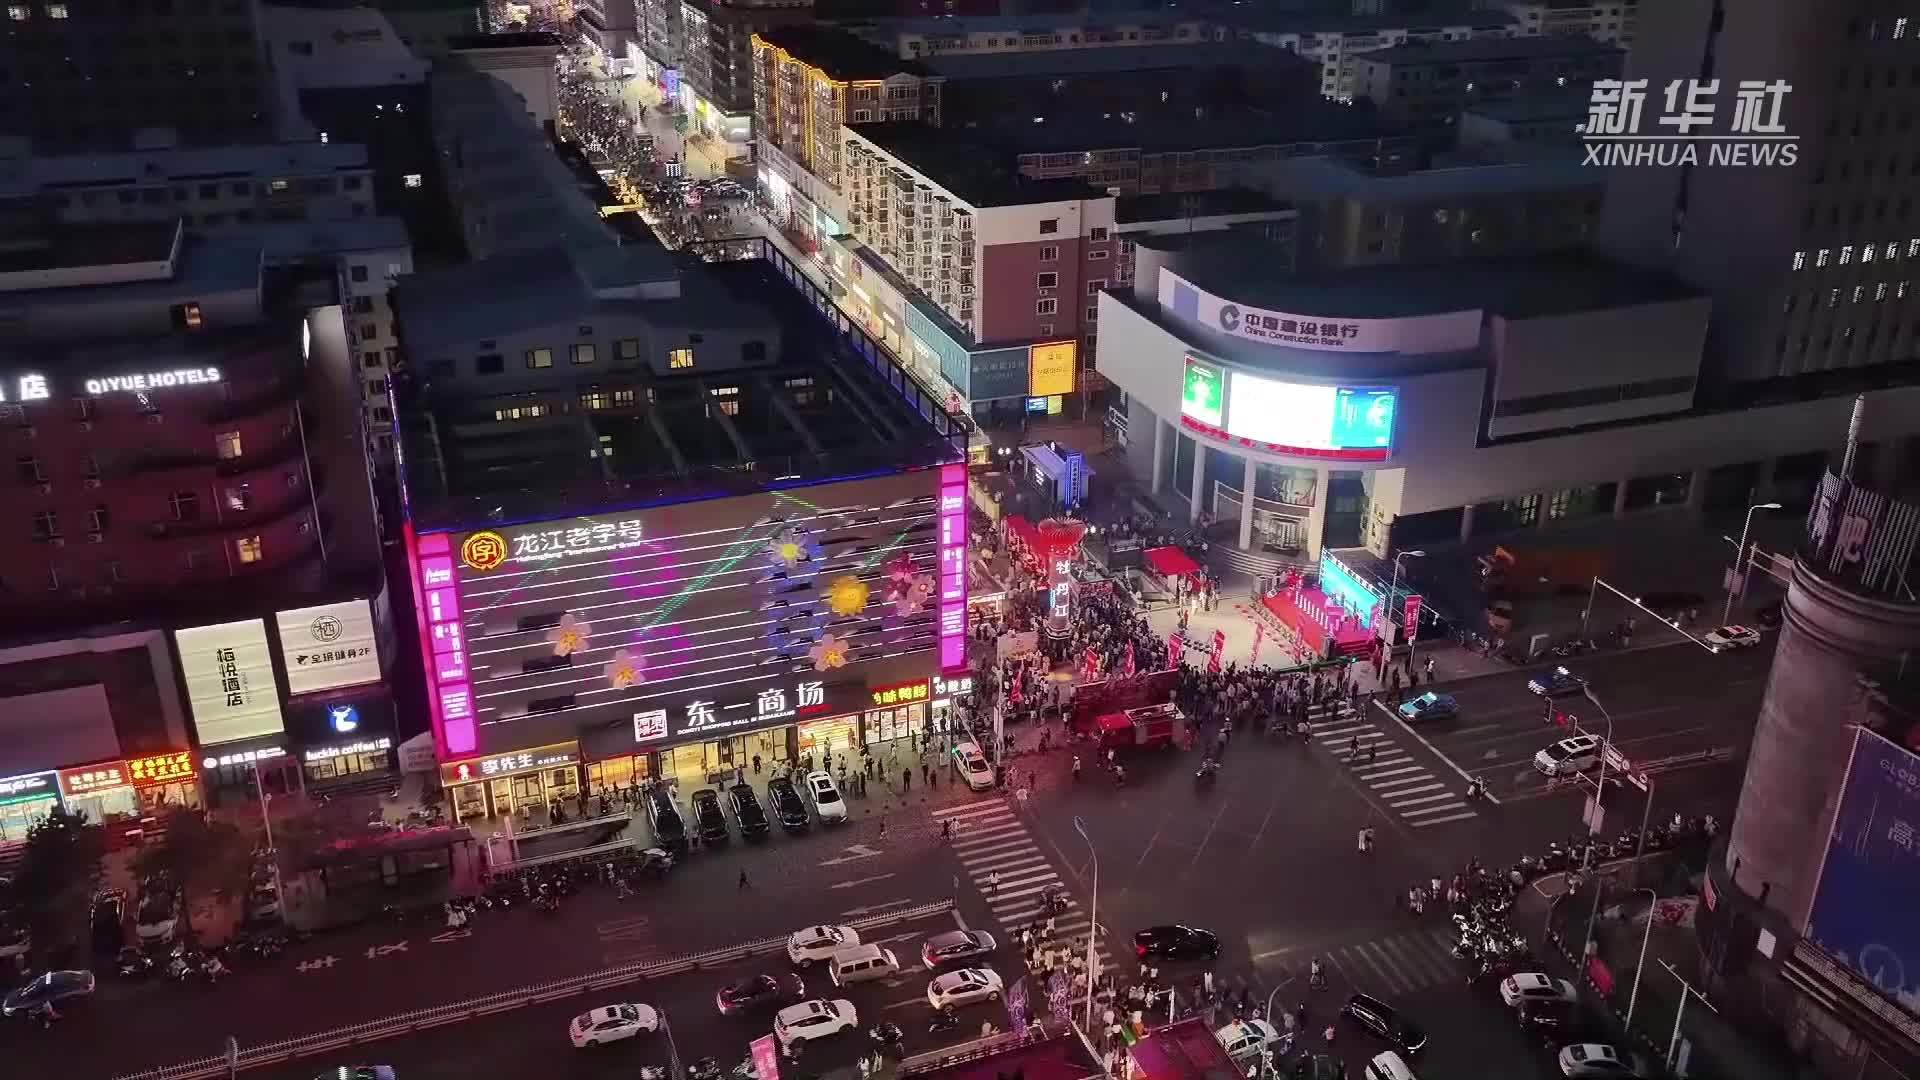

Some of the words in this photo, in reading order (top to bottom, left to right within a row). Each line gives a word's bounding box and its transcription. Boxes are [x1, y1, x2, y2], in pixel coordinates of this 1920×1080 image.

[1245, 313, 1361, 338] 中国建设银行
[86, 376, 145, 394] QIYUE
[149, 367, 220, 387] HOTELS
[513, 519, 641, 556] 龙江老字号
[1055, 560, 1070, 617] 牡丹江
[217, 648, 243, 707] 栖悦酒店
[685, 680, 824, 727] 东一商场
[305, 747, 340, 761] luckin
[342, 741, 375, 755] coffee
[481, 753, 534, 774] 李先生
